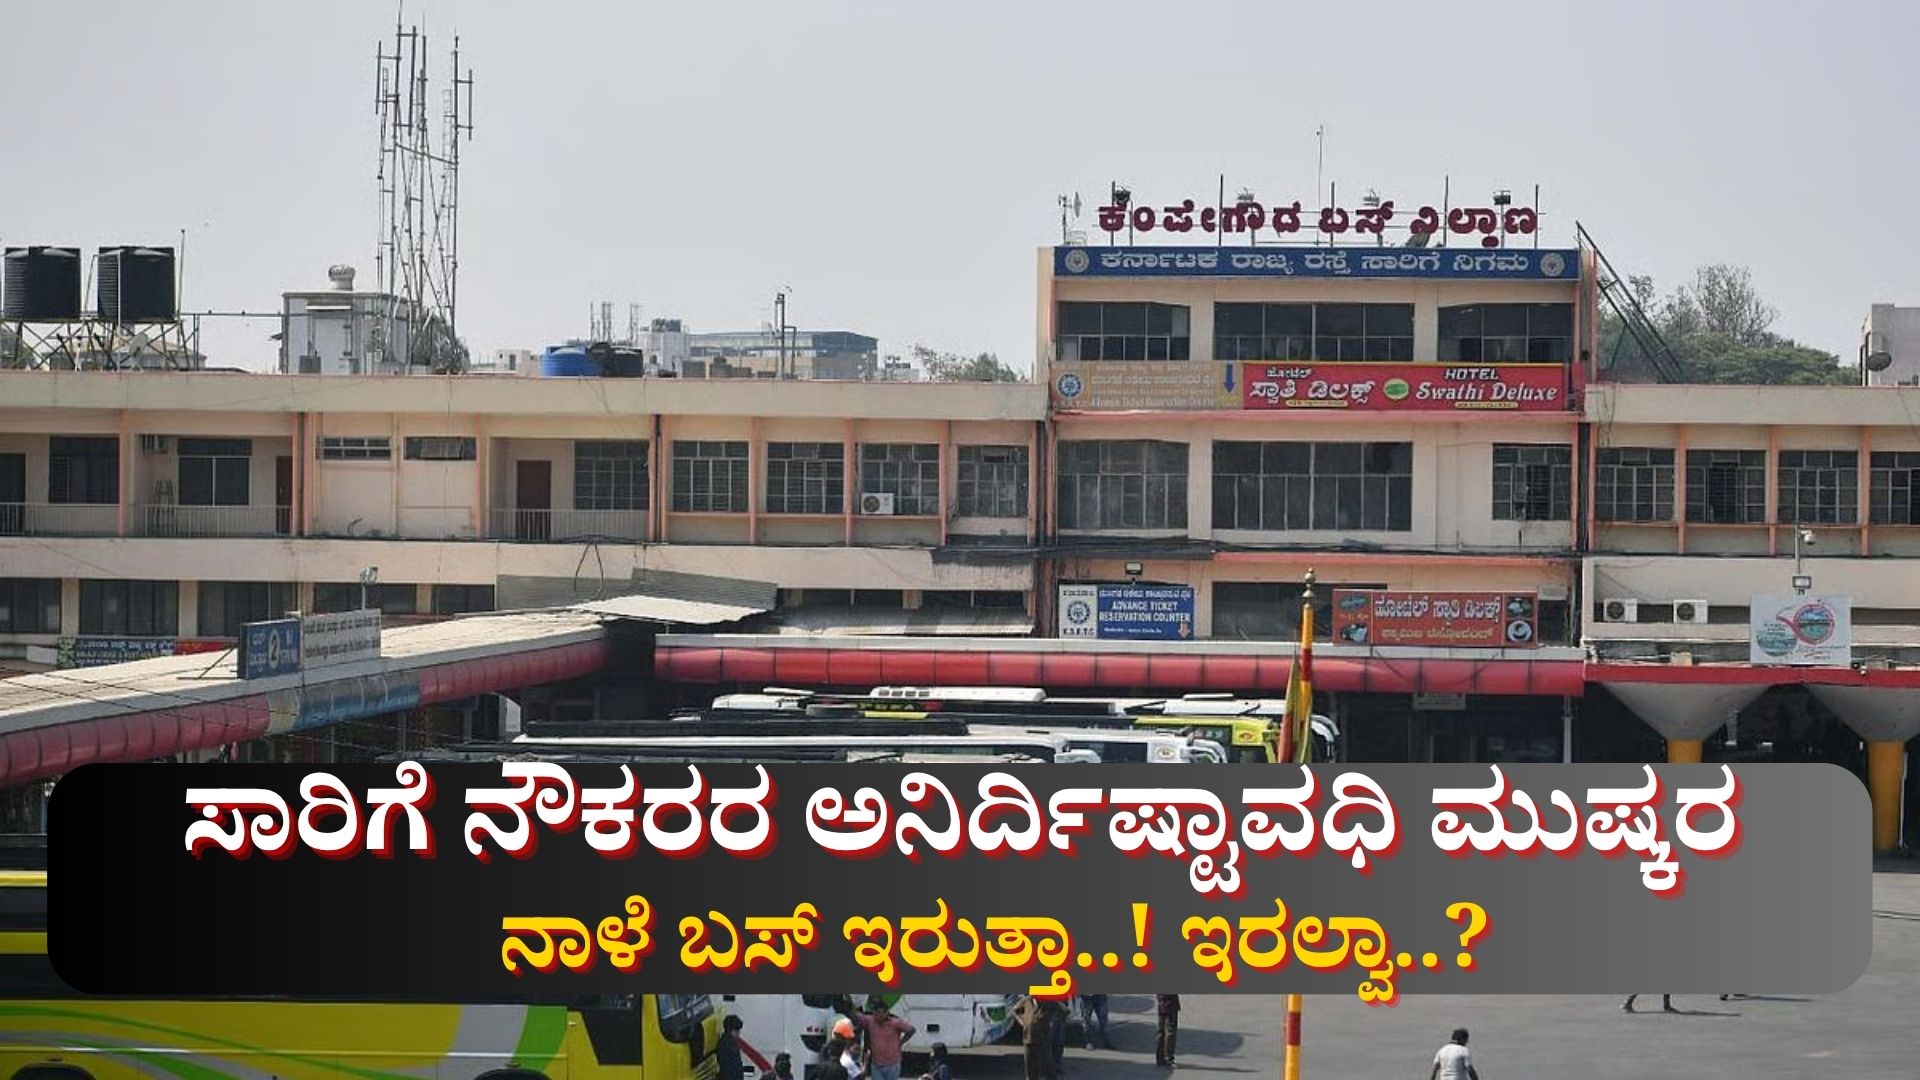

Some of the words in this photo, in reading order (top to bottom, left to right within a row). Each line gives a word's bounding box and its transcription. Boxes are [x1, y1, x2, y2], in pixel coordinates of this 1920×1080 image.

[1318, 201, 1394, 234] ಬಸ್
[1101, 250, 1219, 269] ಕರ್ನಾಟಕ
[1231, 252, 1294, 275] ರಾಜ್ಯ
[1304, 251, 1350, 275] ರಸ್ತೆ
[1361, 251, 1441, 271] ಸಾರಿಗೆ
[1453, 253, 1529, 271] ನಿಗಮ
[1444, 367, 1500, 381] HOTEL
[1249, 379, 1297, 405] ಸ್ವಾತಿ
[1415, 382, 1486, 401] Swathi
[1489, 382, 1558, 401] Deluxe
[1111, 600, 1148, 611] ADVANCE
[1150, 600, 1178, 611] TICKET
